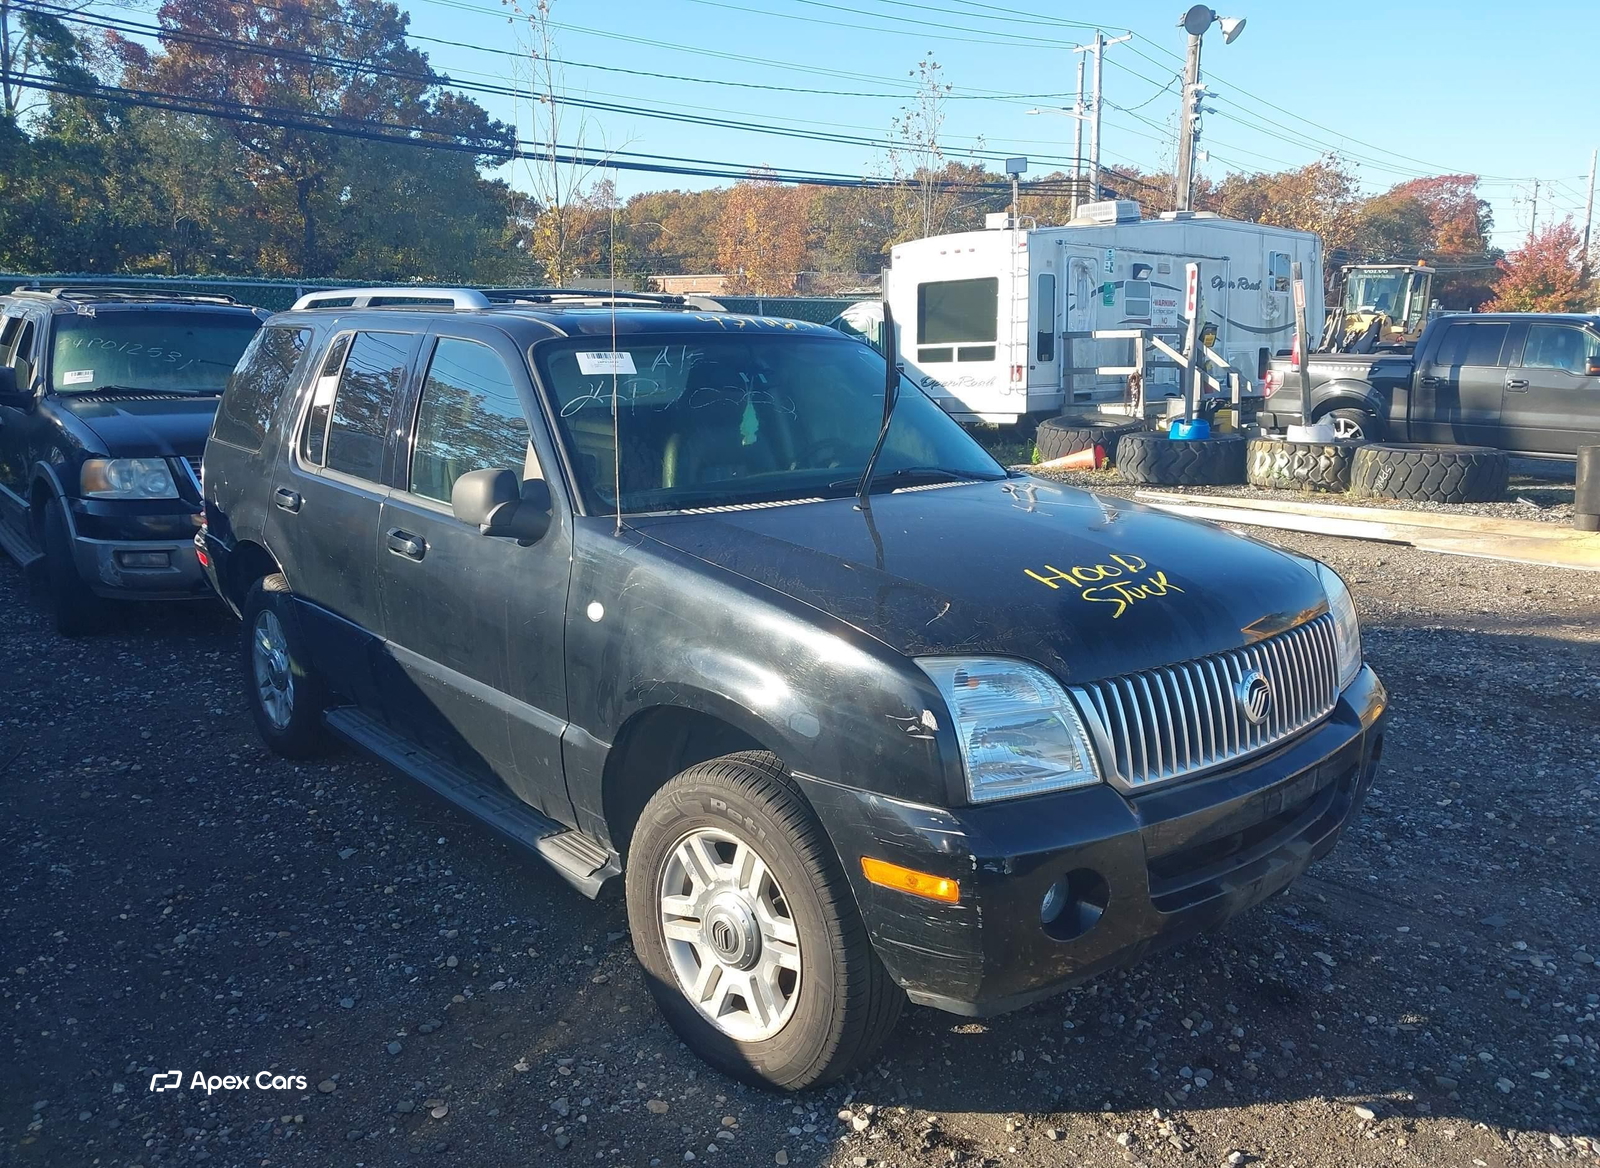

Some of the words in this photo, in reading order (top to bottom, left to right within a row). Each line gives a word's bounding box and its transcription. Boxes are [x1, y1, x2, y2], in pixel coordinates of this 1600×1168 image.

[1237, 276, 1262, 291] Road
[920, 375, 958, 391] Open
[959, 375, 997, 388] Road
[1023, 554, 1147, 589] HOOD
